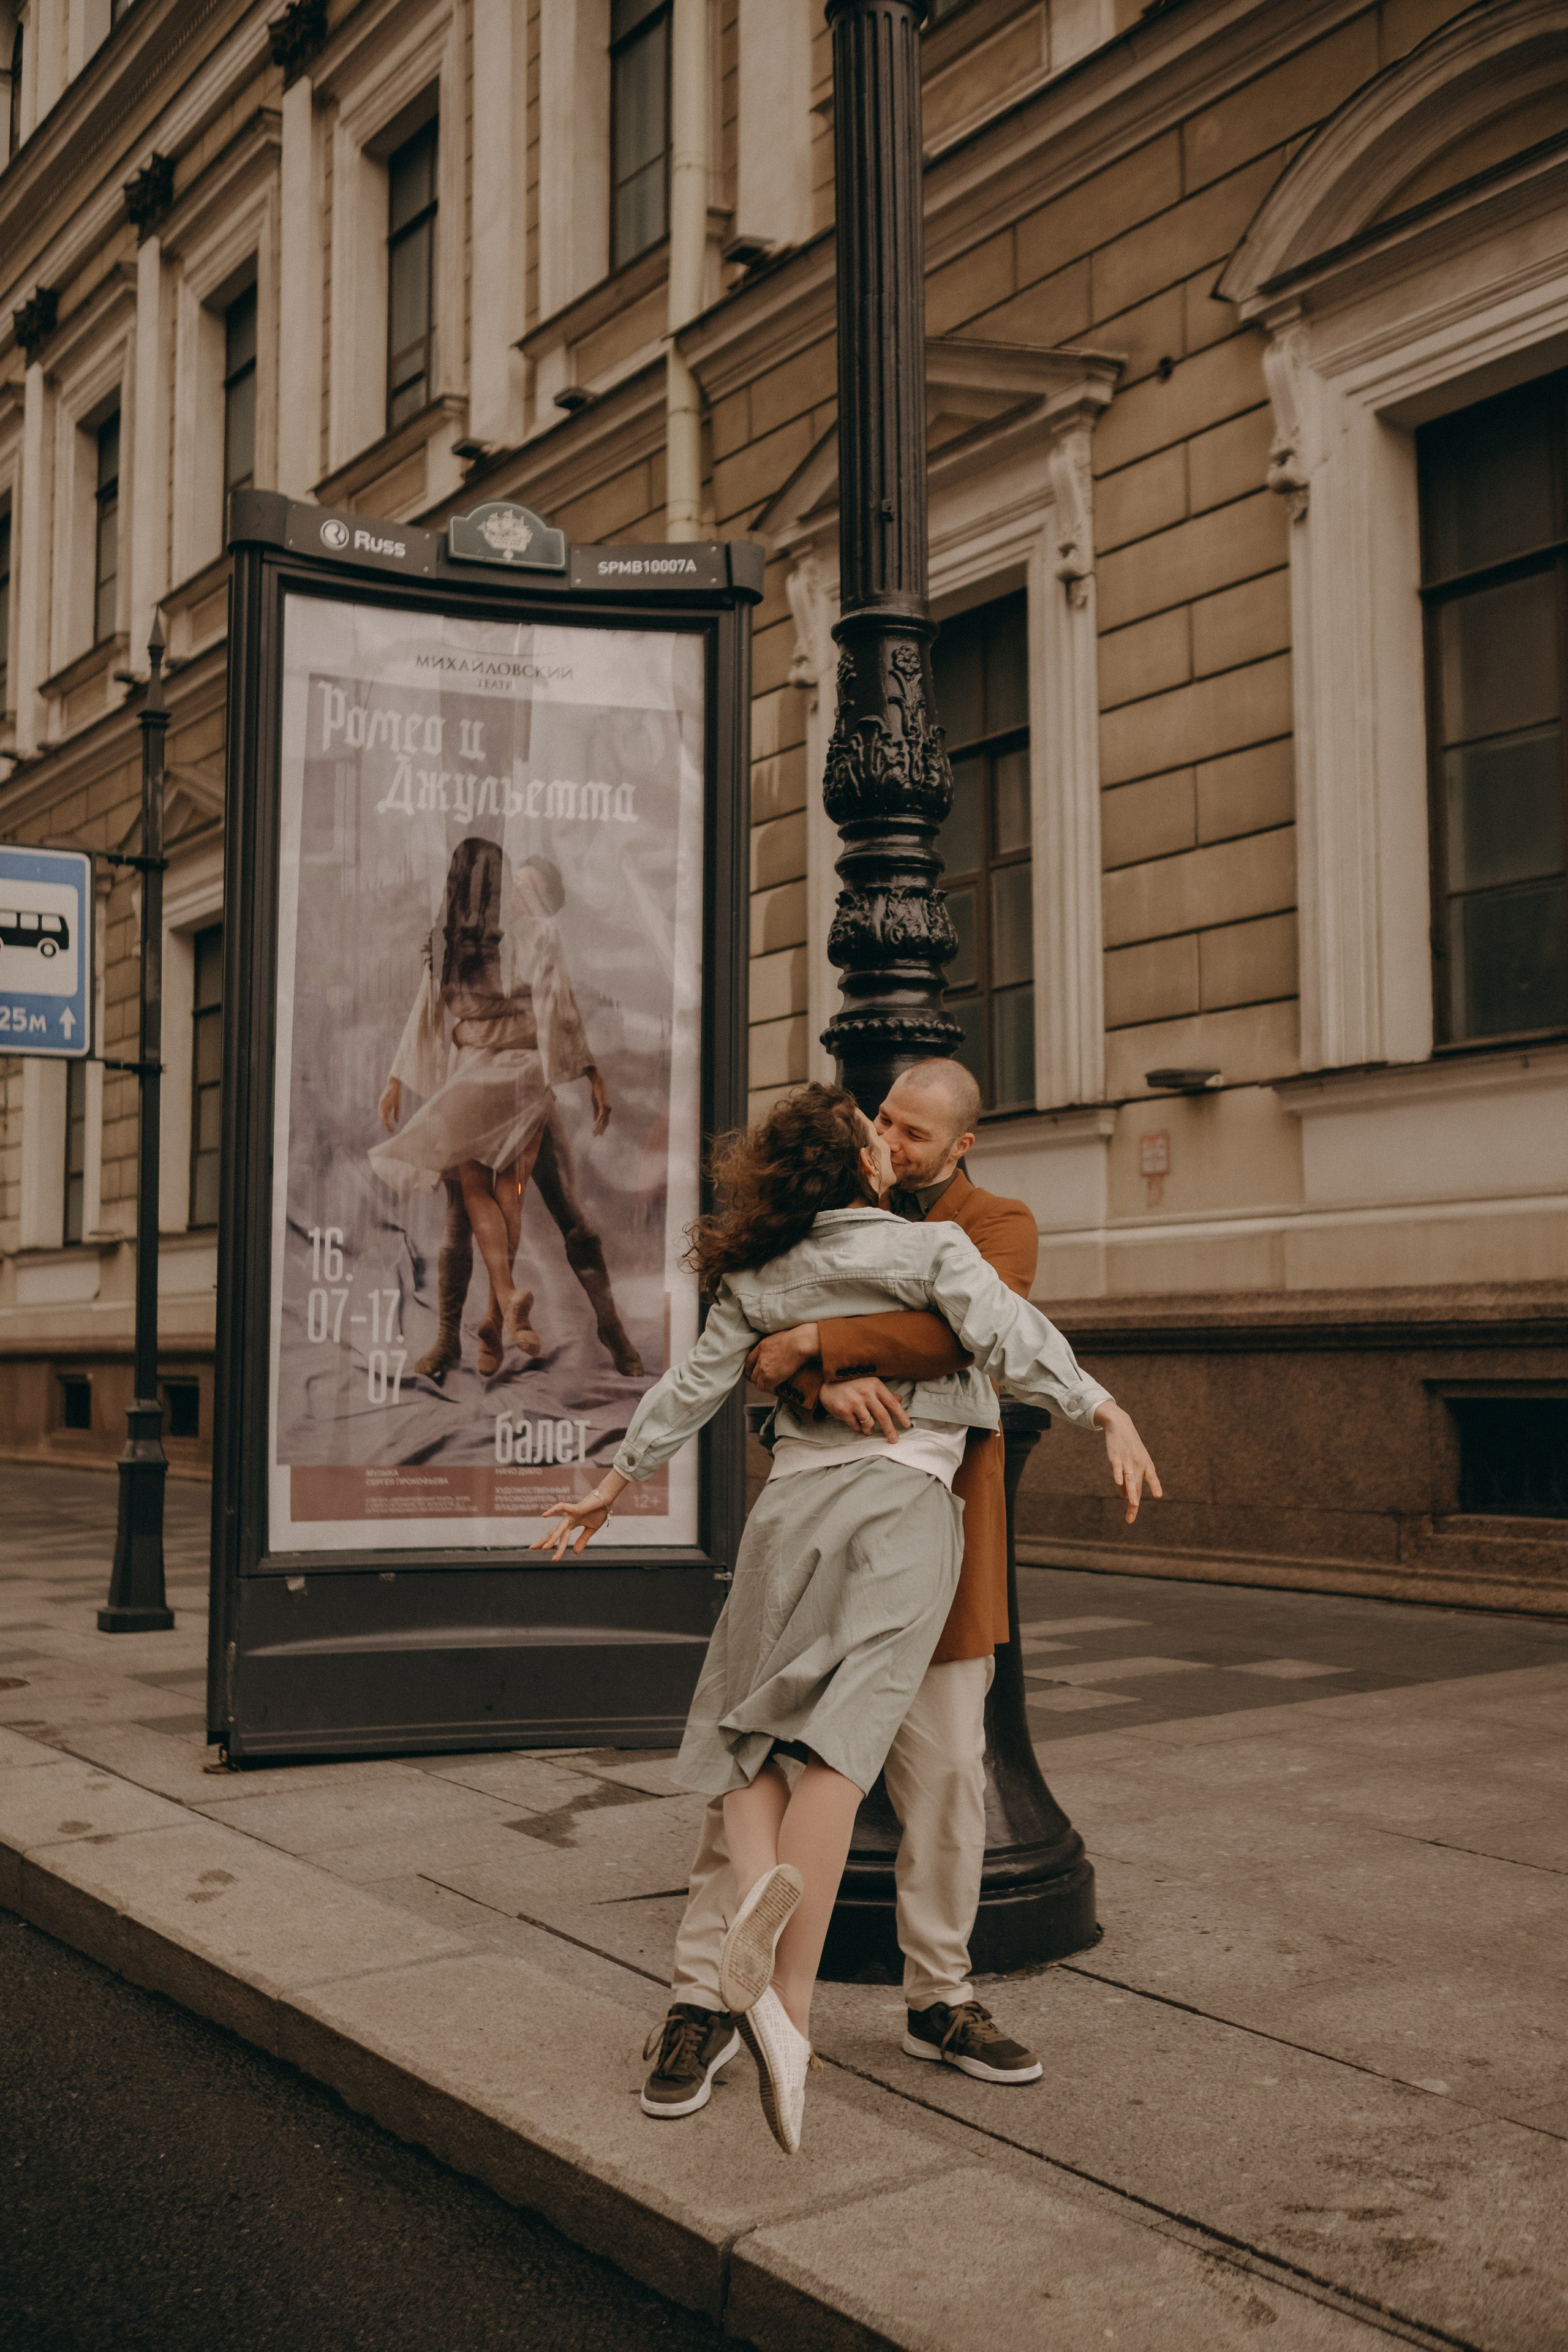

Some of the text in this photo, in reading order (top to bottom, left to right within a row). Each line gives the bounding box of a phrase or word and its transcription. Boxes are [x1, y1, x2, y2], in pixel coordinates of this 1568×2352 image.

[354, 529, 405, 558] Russ
[597, 559, 697, 575] SPMB10007A
[318, 681, 486, 761] Ромео и
[375, 755, 639, 824] Джульетта
[308, 1227, 353, 1282] 16.
[369, 1349, 407, 1404] 07
[496, 1410, 590, 1464] балет
[633, 1494, 660, 1508] 12+
